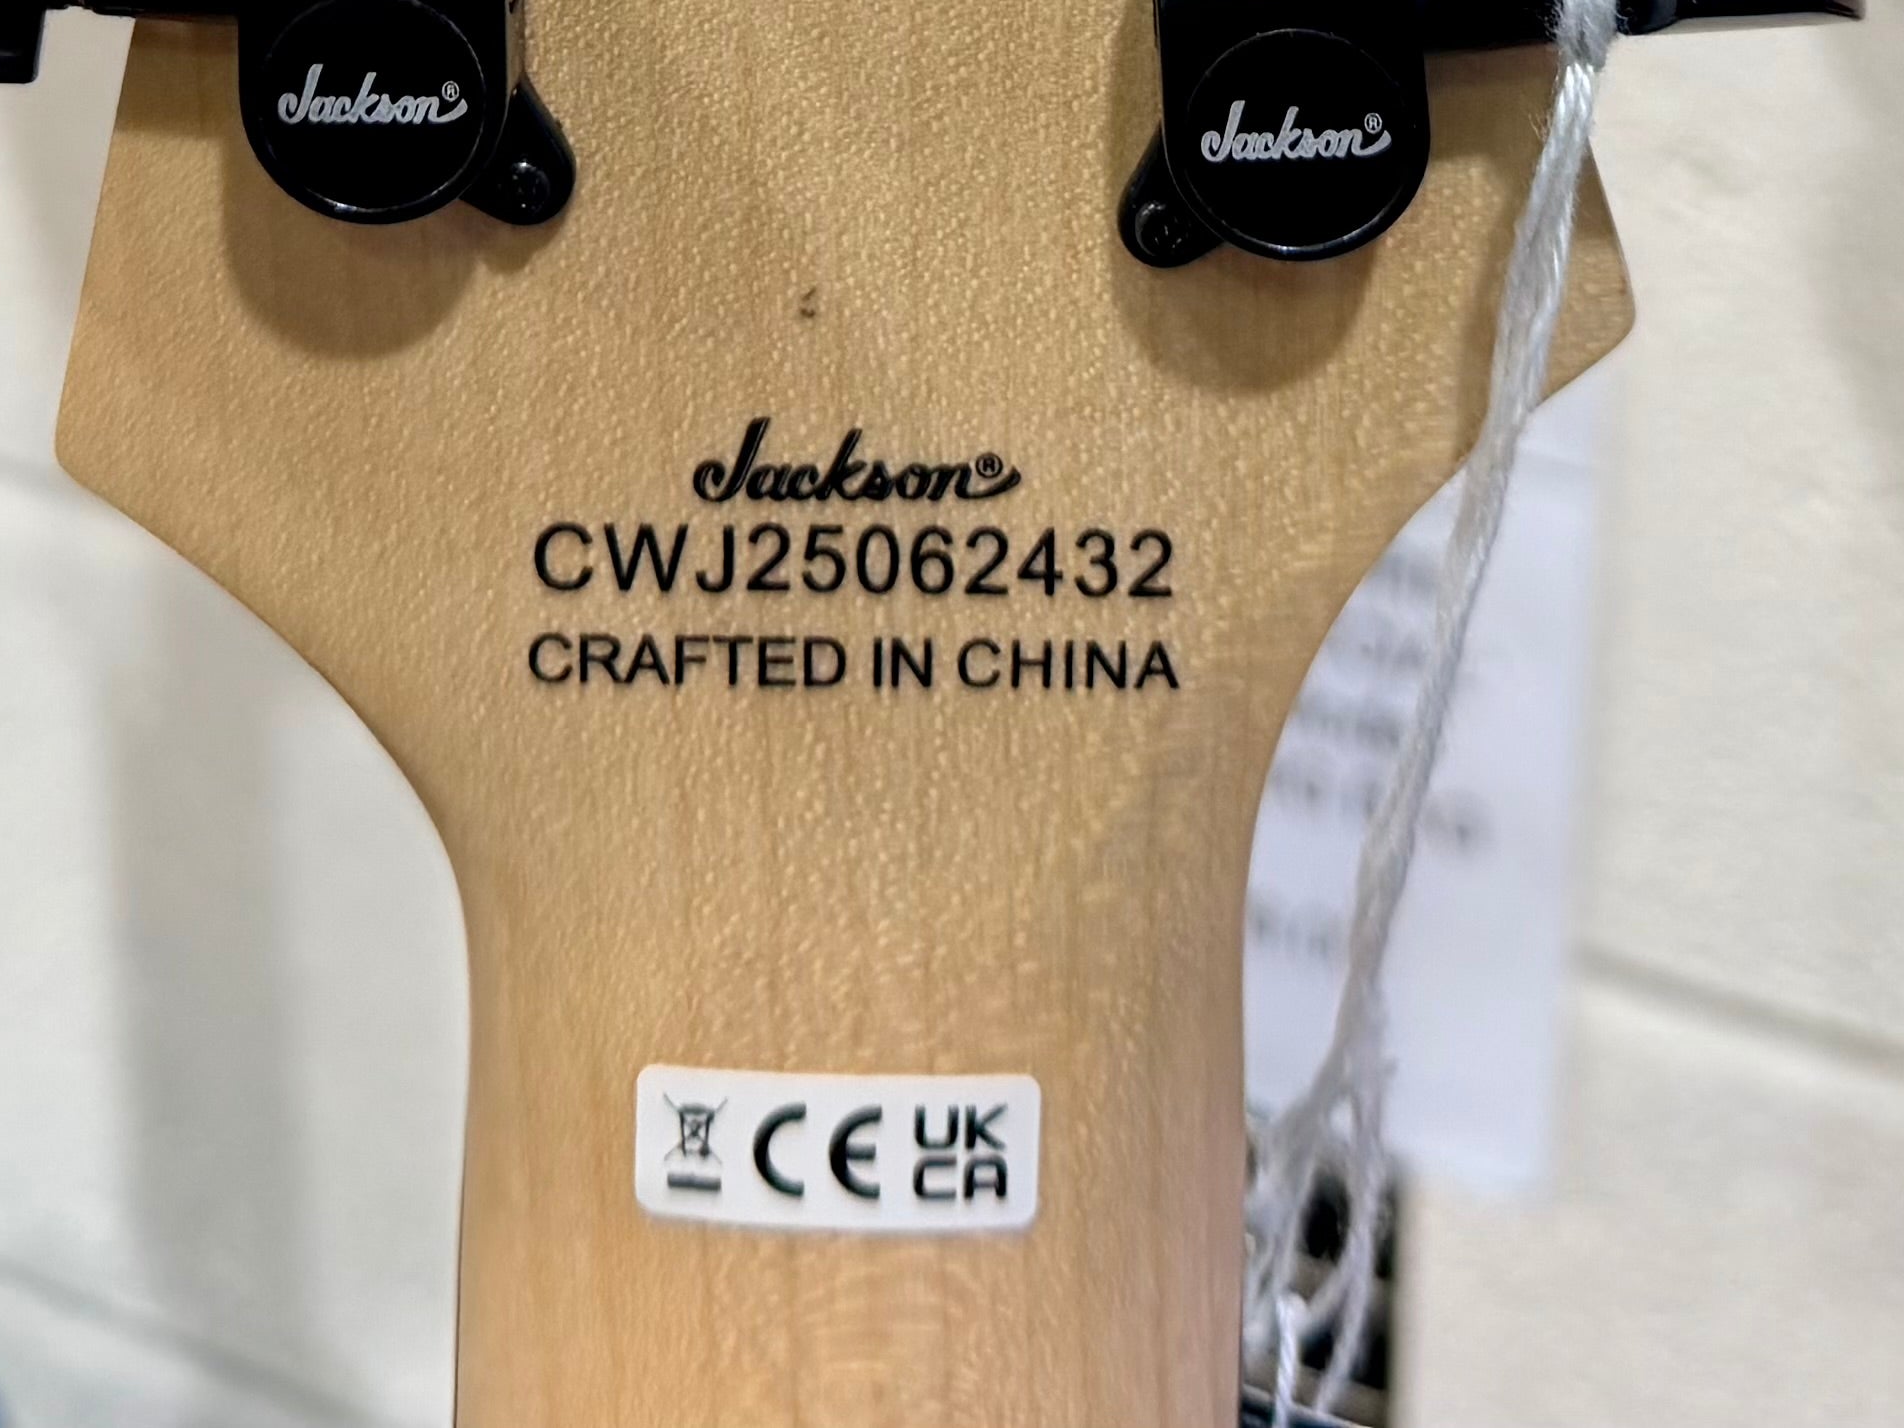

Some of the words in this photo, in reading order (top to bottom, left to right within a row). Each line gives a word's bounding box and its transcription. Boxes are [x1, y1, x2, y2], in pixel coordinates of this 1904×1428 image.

[532, 522, 1175, 600] CWJ25062432
[527, 632, 848, 691] CRAFTED
[872, 637, 935, 691] IN
[956, 637, 1181, 692] CHINA
[751, 1102, 884, 1200] CE
[912, 1103, 1010, 1152] UK
[912, 1154, 1010, 1201] CA
